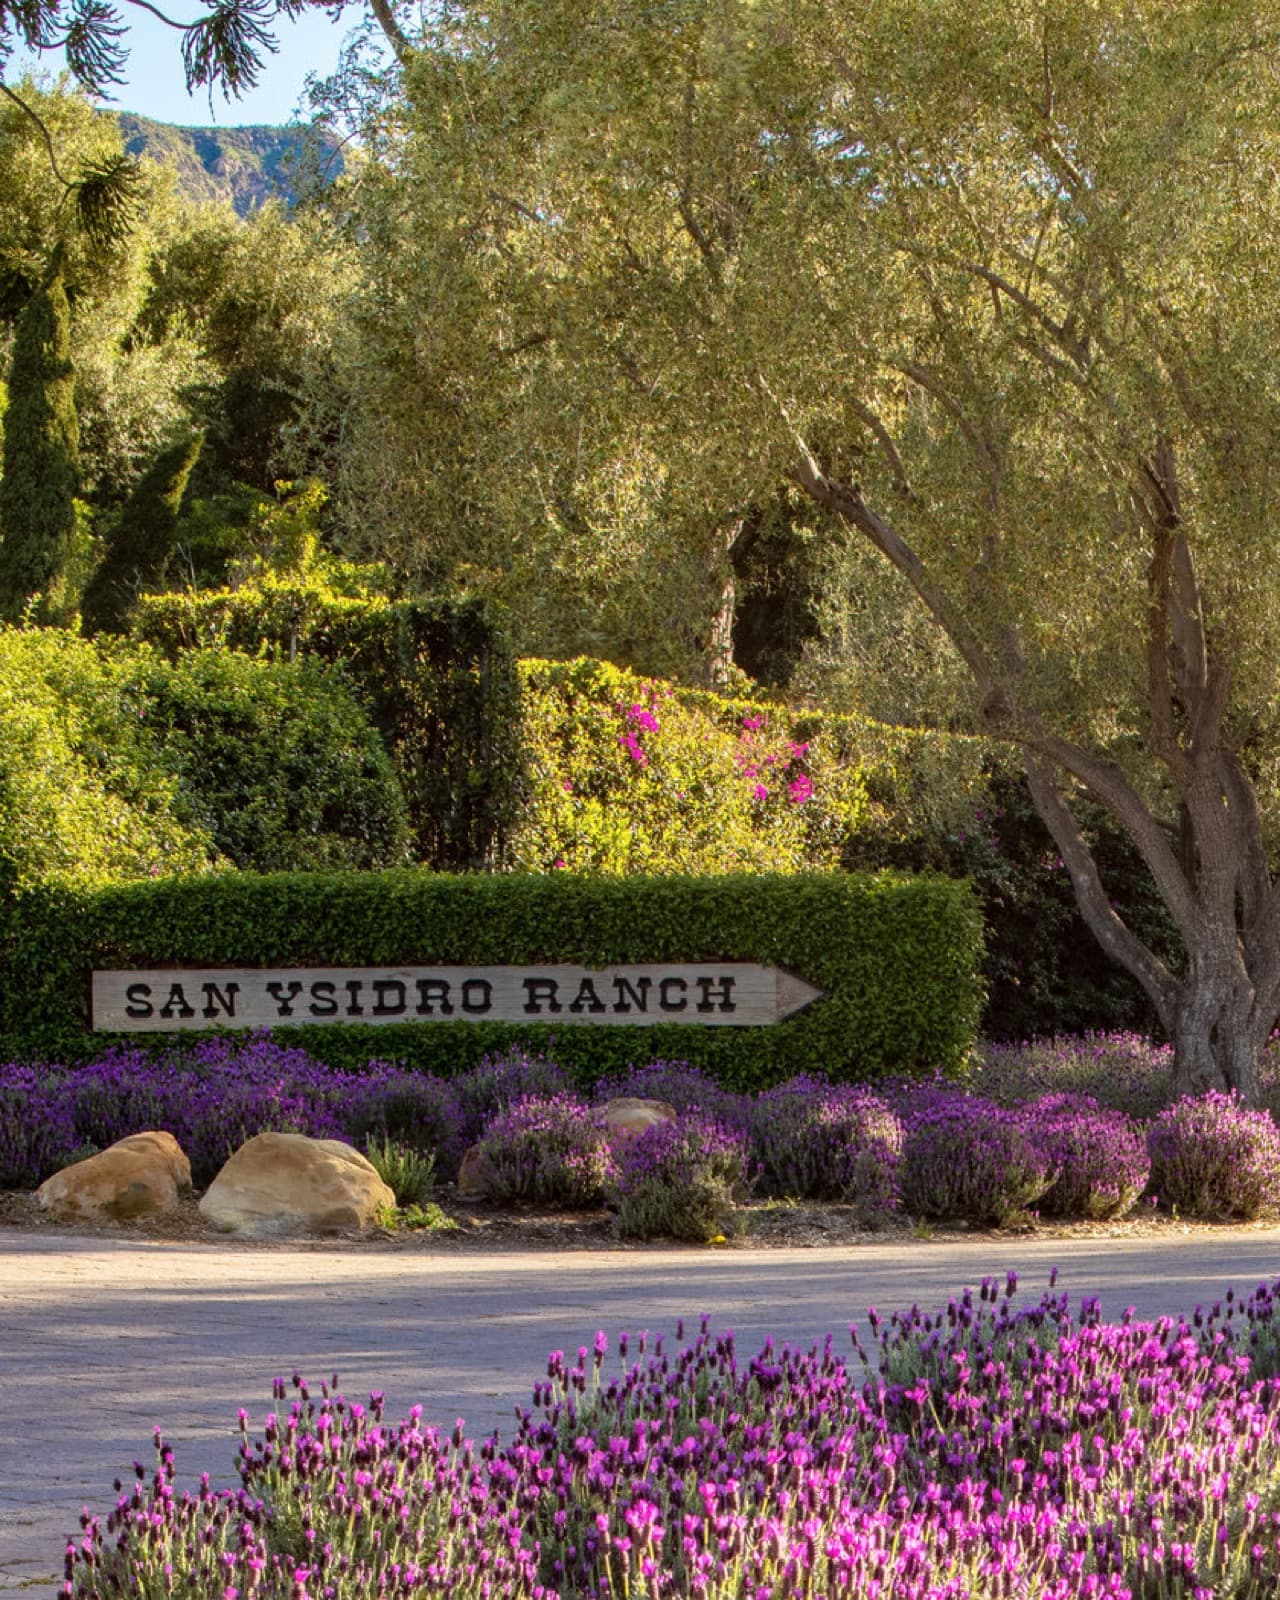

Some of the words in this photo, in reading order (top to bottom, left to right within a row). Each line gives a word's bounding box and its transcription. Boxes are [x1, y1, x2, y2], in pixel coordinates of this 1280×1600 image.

[125, 982, 240, 1018] SAN
[266, 979, 493, 1016] YSIDRO
[522, 976, 737, 1014] RANCH
